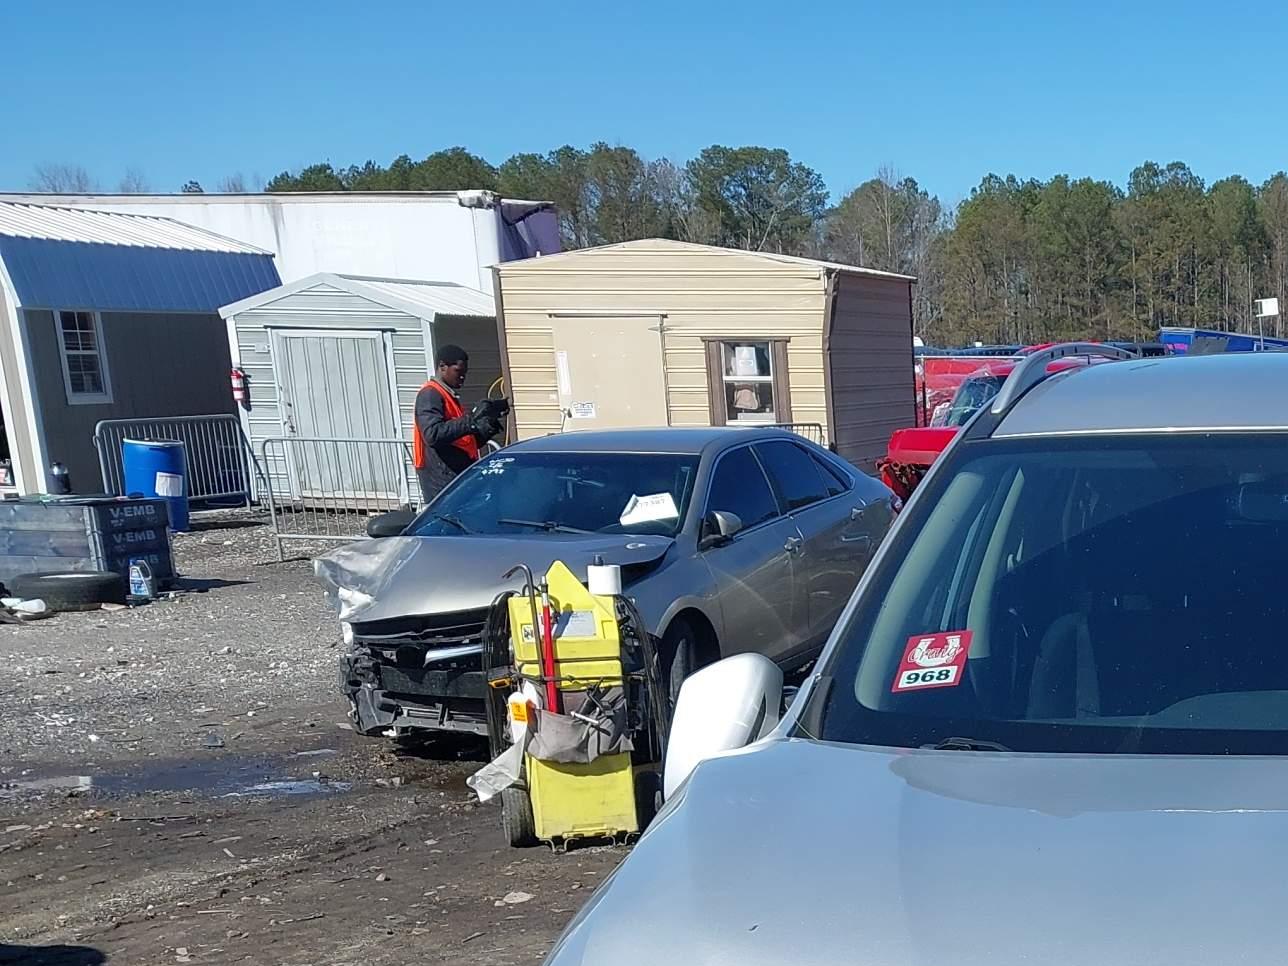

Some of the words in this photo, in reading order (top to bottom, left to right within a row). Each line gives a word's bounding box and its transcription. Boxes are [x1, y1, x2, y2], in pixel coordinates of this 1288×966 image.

[850, 368, 879, 395] VIC
[841, 401, 883, 427] CARS
[904, 669, 951, 685] 968
